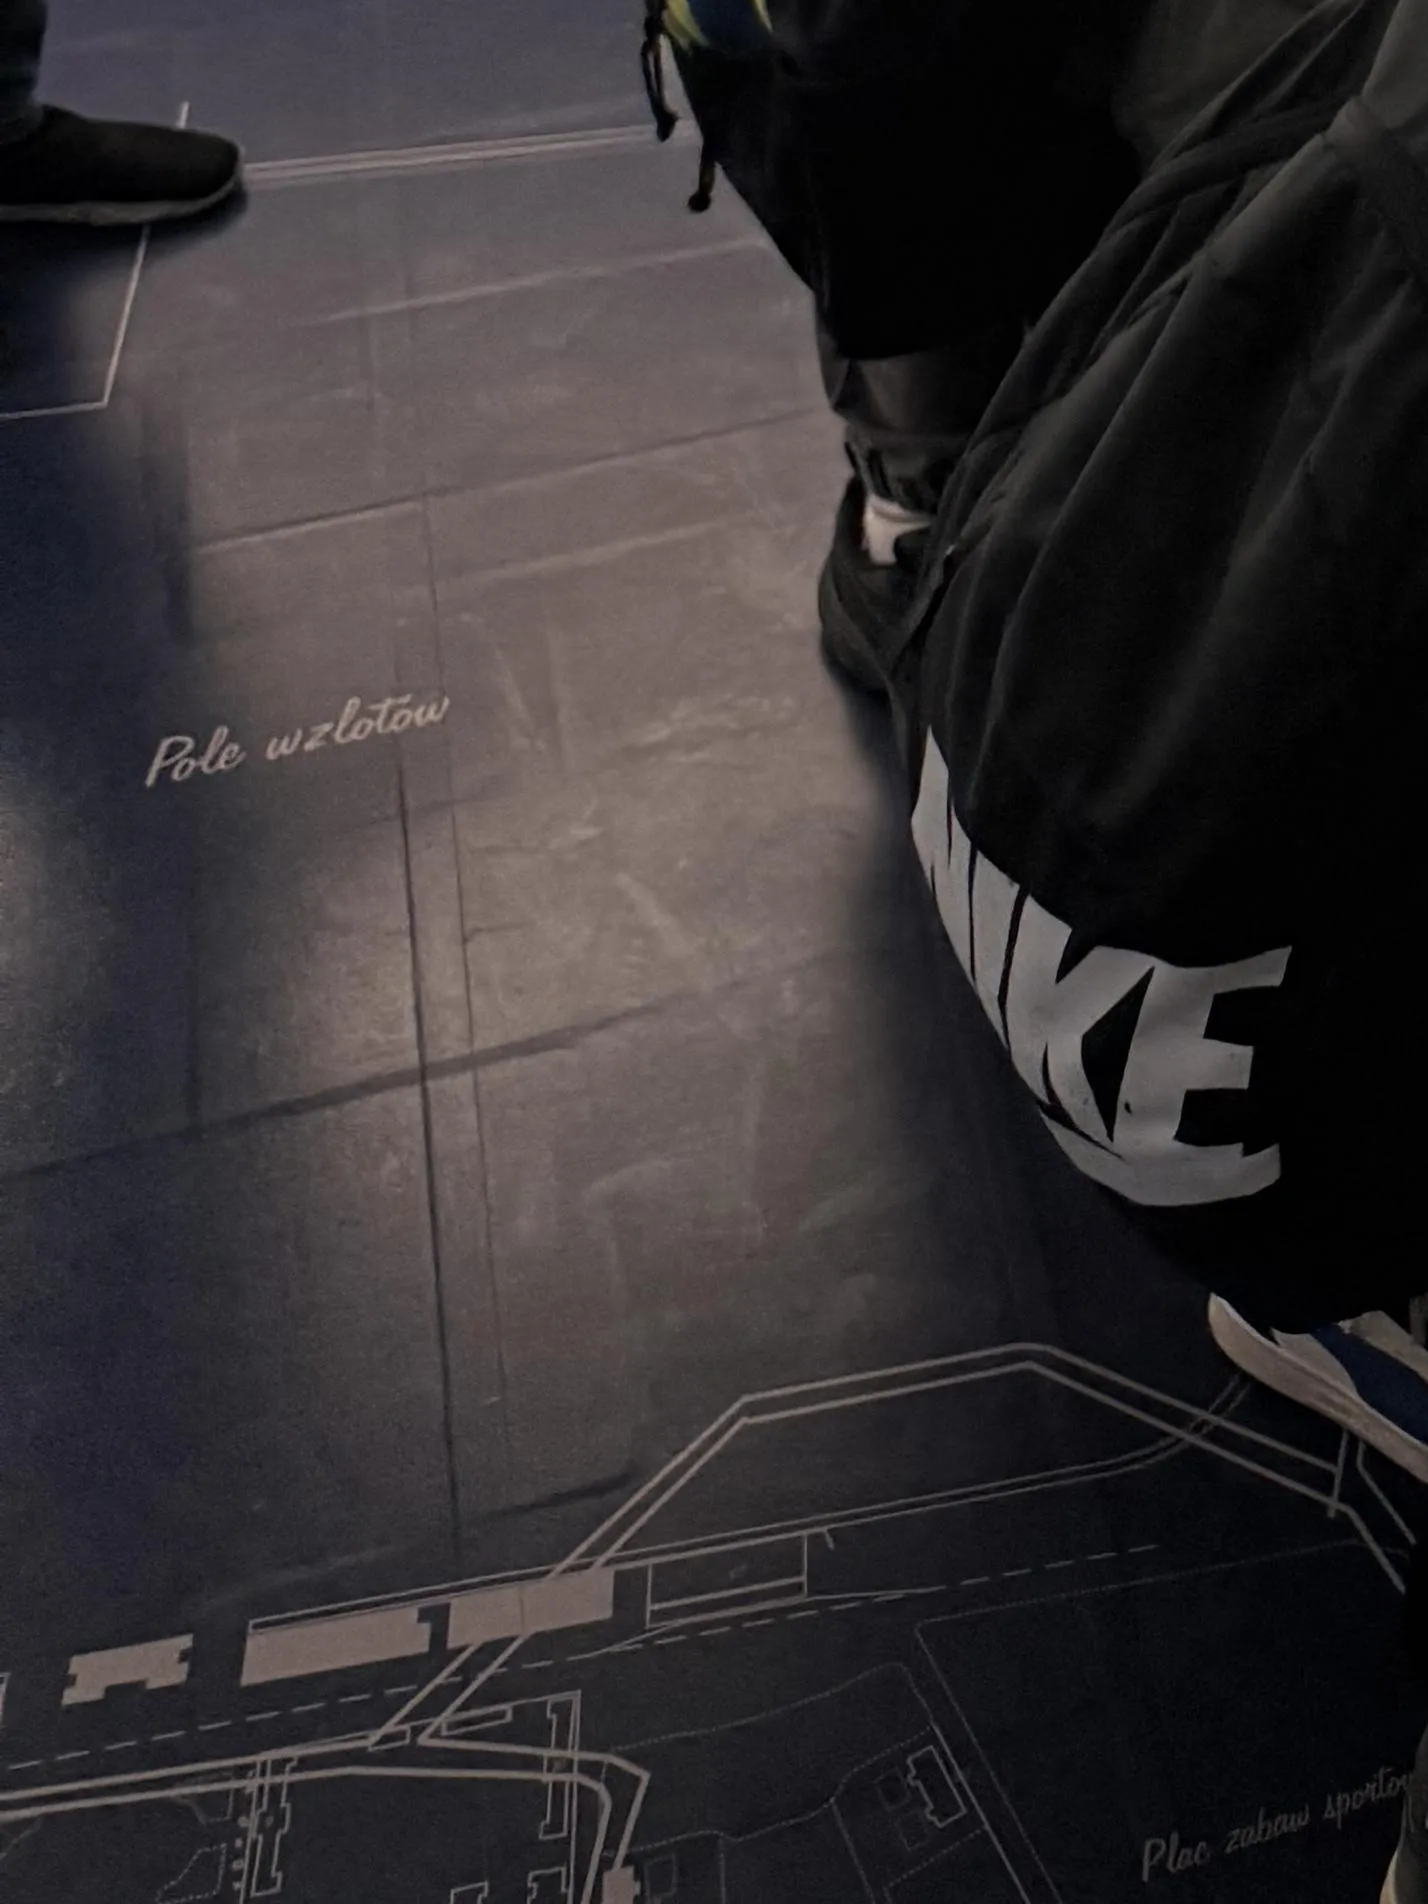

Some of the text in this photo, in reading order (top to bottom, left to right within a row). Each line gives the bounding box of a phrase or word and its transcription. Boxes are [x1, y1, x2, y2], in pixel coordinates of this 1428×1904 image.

[145, 725, 246, 787] Pole
[1141, 1831, 1210, 1883] Plac
[1225, 1807, 1310, 1855] zabaw
